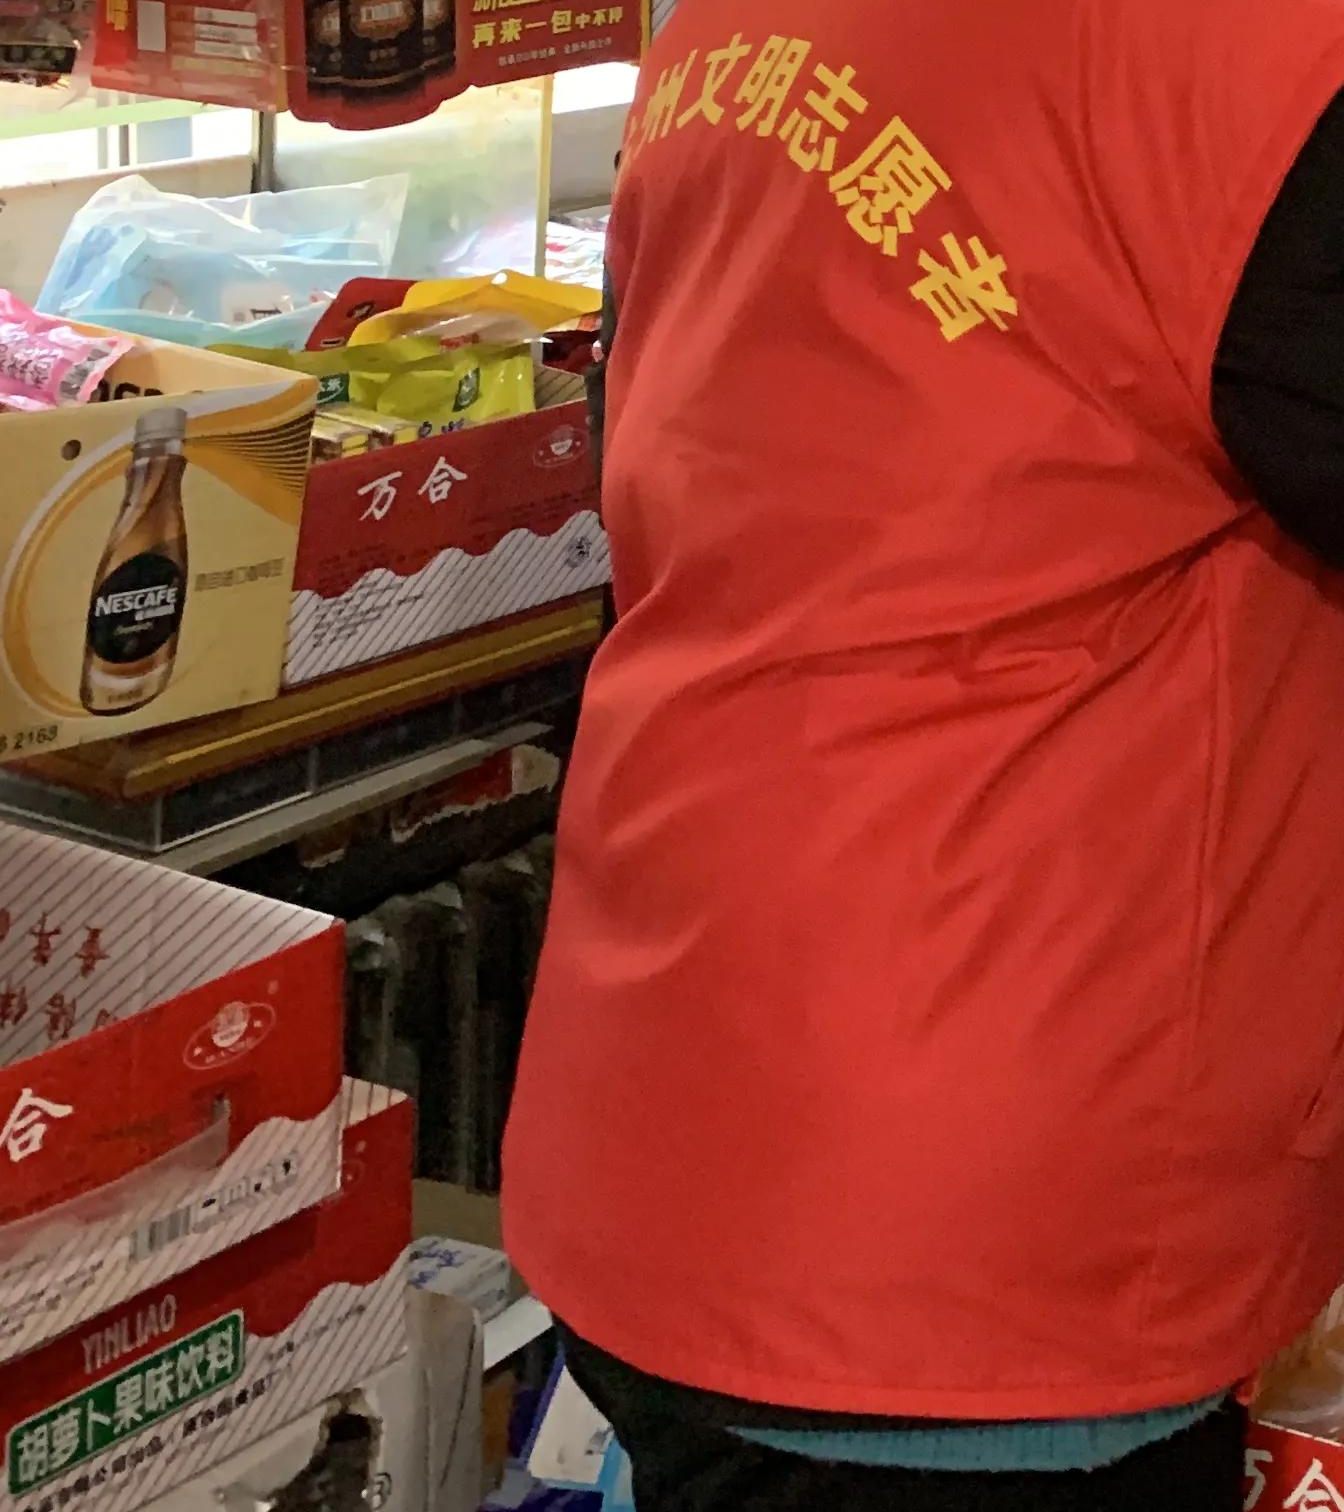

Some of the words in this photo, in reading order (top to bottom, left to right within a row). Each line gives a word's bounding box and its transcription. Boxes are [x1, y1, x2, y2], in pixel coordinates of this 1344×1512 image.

[472, 9, 573, 49] 再来一包
[616, 32, 1018, 343] 州文明志愿者
[357, 457, 467, 522] 万合
[95, 588, 178, 617] NESCAFE
[18, 1324, 234, 1483] 胡萝卜果味饮料
